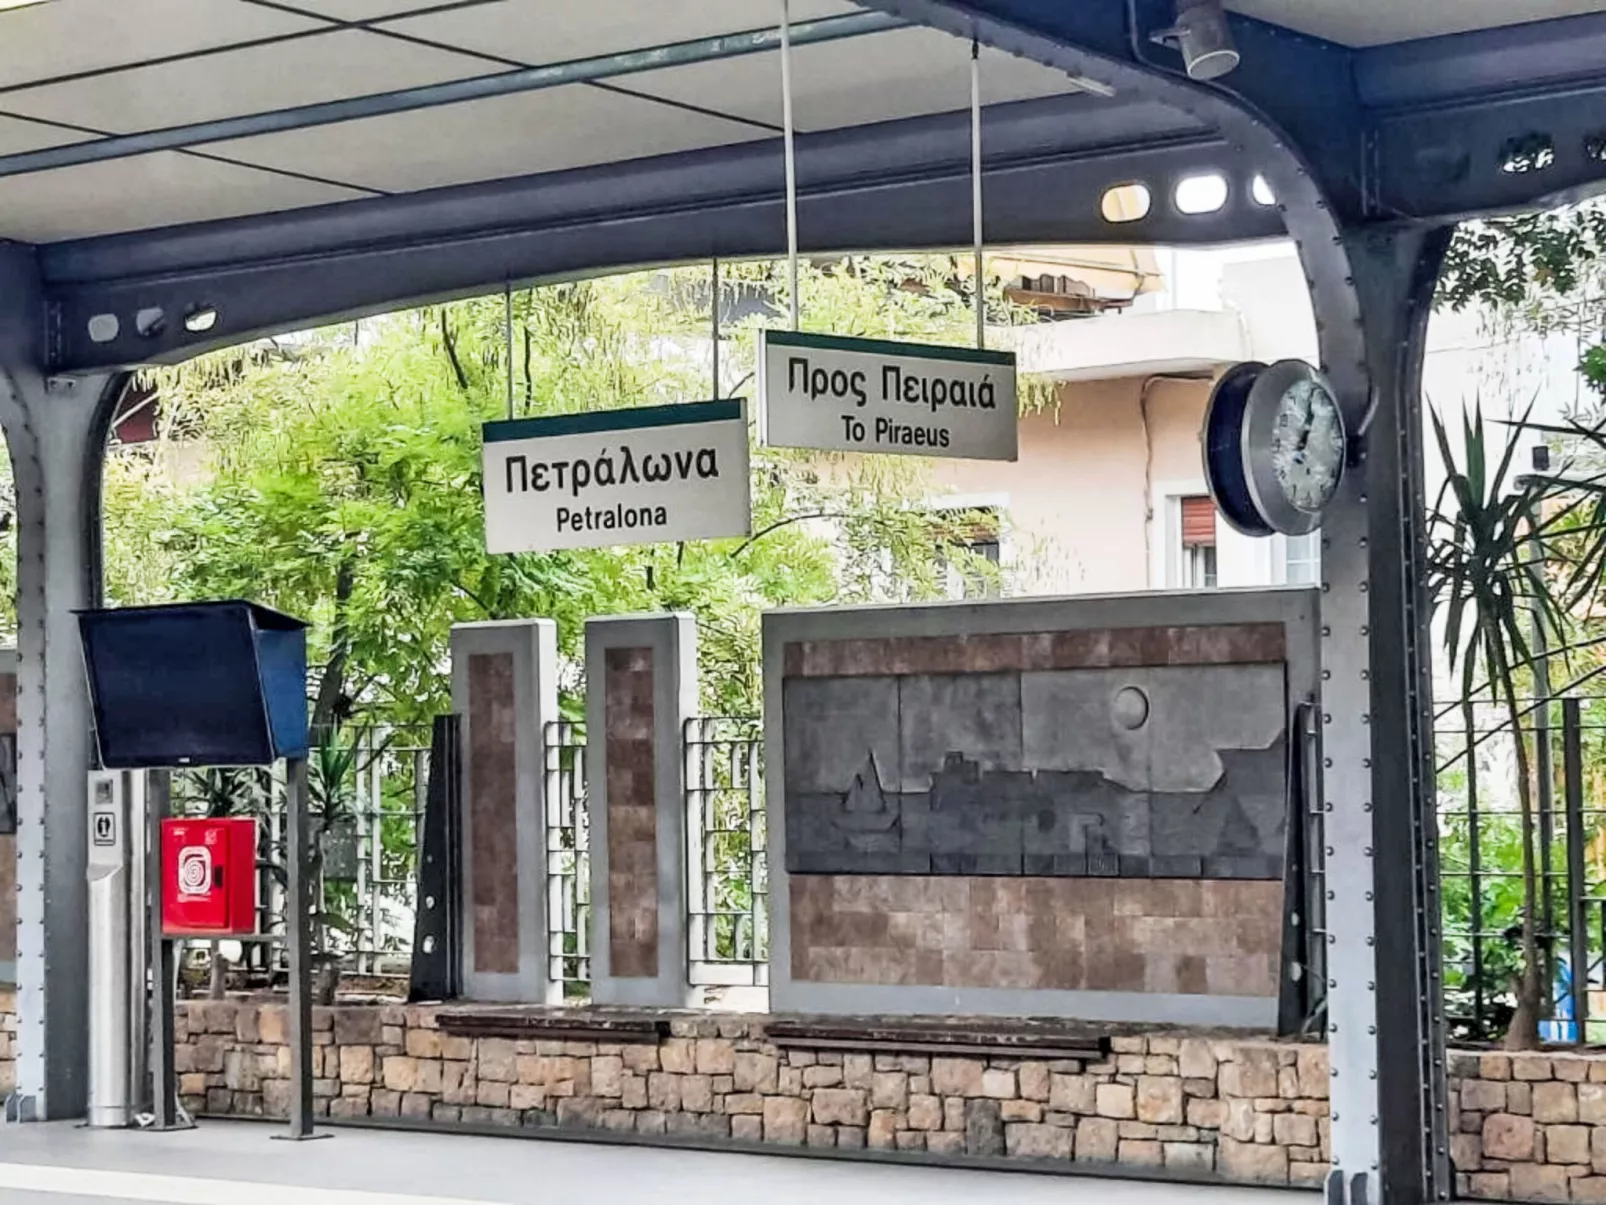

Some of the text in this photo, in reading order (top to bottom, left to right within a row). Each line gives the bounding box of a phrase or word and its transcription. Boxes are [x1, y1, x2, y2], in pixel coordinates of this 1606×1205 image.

[788, 357, 997, 413] Προς Πειραιά
[841, 414, 950, 449] To Piraeus
[505, 446, 719, 497] Πετράλωνα
[556, 504, 667, 533] Petralona
